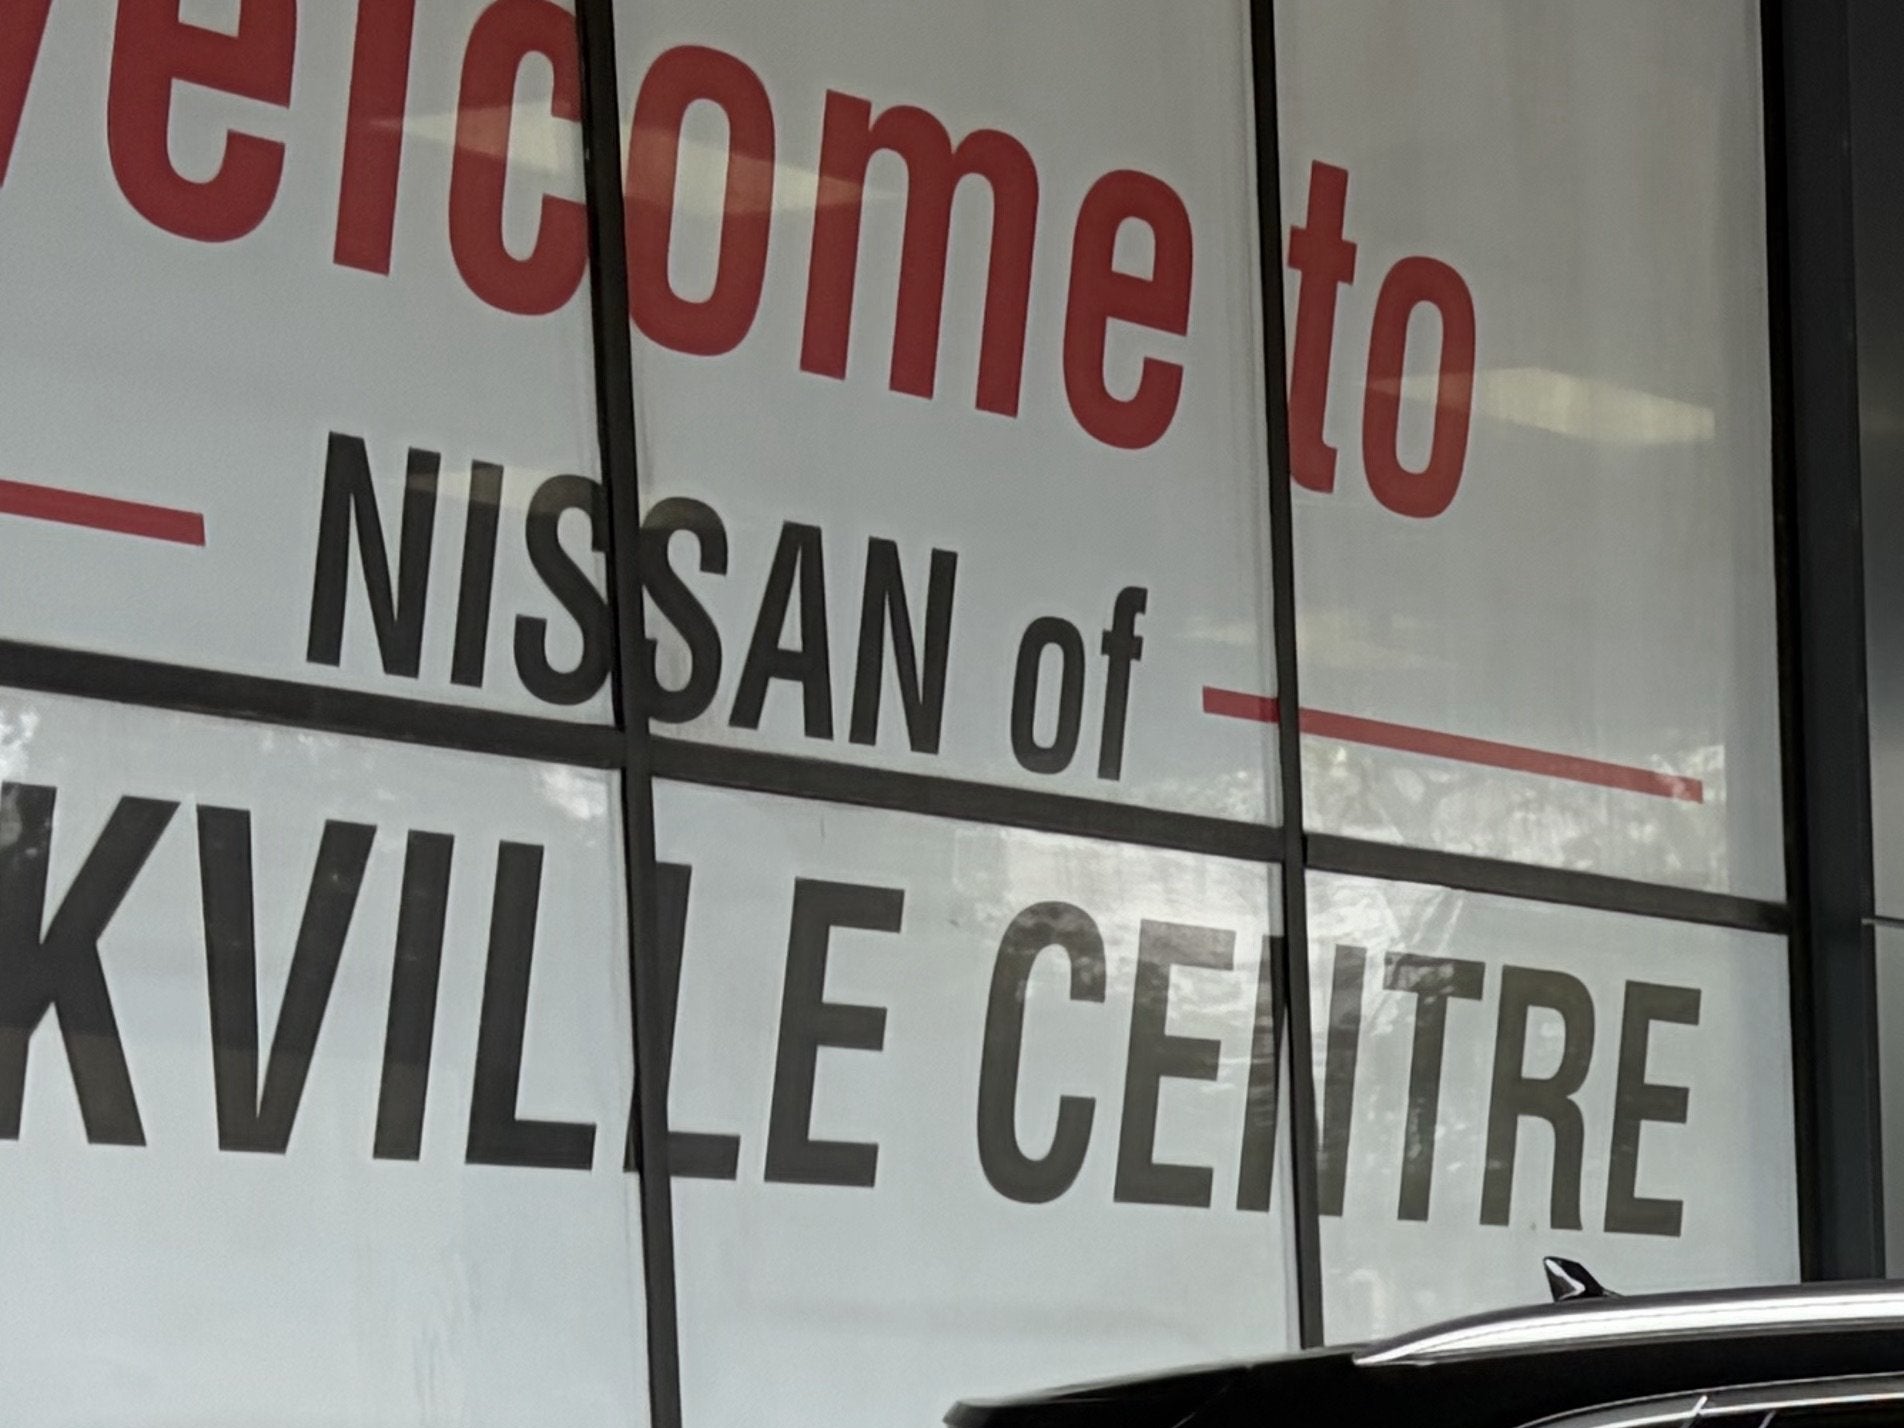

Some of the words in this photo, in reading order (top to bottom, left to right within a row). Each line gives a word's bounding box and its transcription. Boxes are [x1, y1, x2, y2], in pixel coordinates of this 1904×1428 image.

[0, 0, 1193, 450] elcome
[1287, 159, 1477, 519] to
[306, 430, 959, 755] NISSAN
[1010, 586, 1149, 781] of
[0, 779, 906, 1189] KVILLE
[976, 900, 1703, 1237] CENTRE
